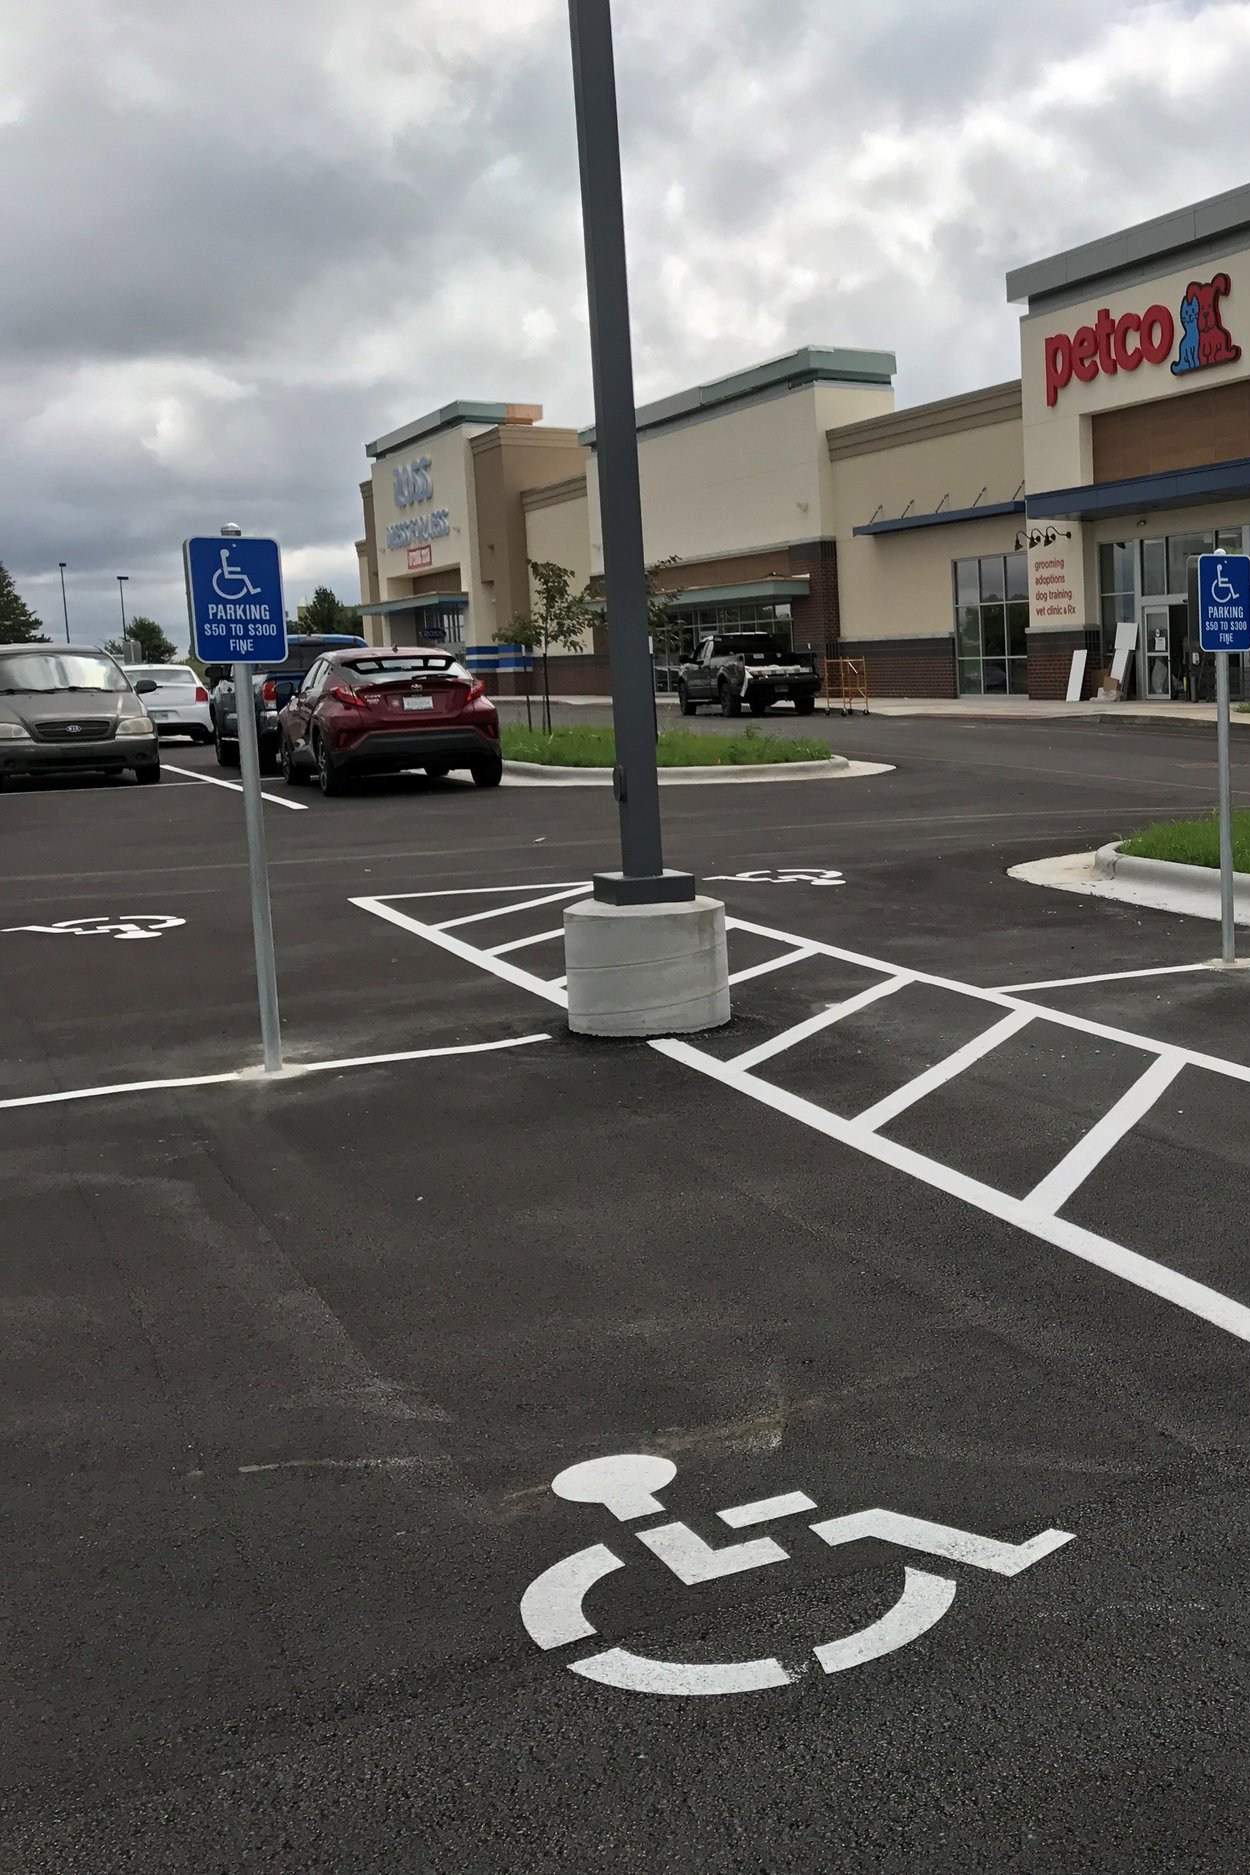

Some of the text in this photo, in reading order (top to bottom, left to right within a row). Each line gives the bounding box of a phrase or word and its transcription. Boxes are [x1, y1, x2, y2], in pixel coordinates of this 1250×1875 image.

[1045, 304, 1175, 407] petco
[1035, 558, 1065, 571] grooming
[1035, 574, 1065, 586] adoptions
[1036, 589, 1072, 602] dog training
[208, 604, 270, 620] PARKING
[1036, 606, 1046, 616] vet
[1047, 605, 1062, 616] clinic
[1067, 604, 1076, 615] Rx
[1208, 606, 1244, 619] PARKING
[204, 623, 277, 636] $50 TO $300
[1205, 621, 1247, 631] $50 TO $300
[1219, 633, 1234, 643] FINE
[230, 639, 254, 651] FINE
